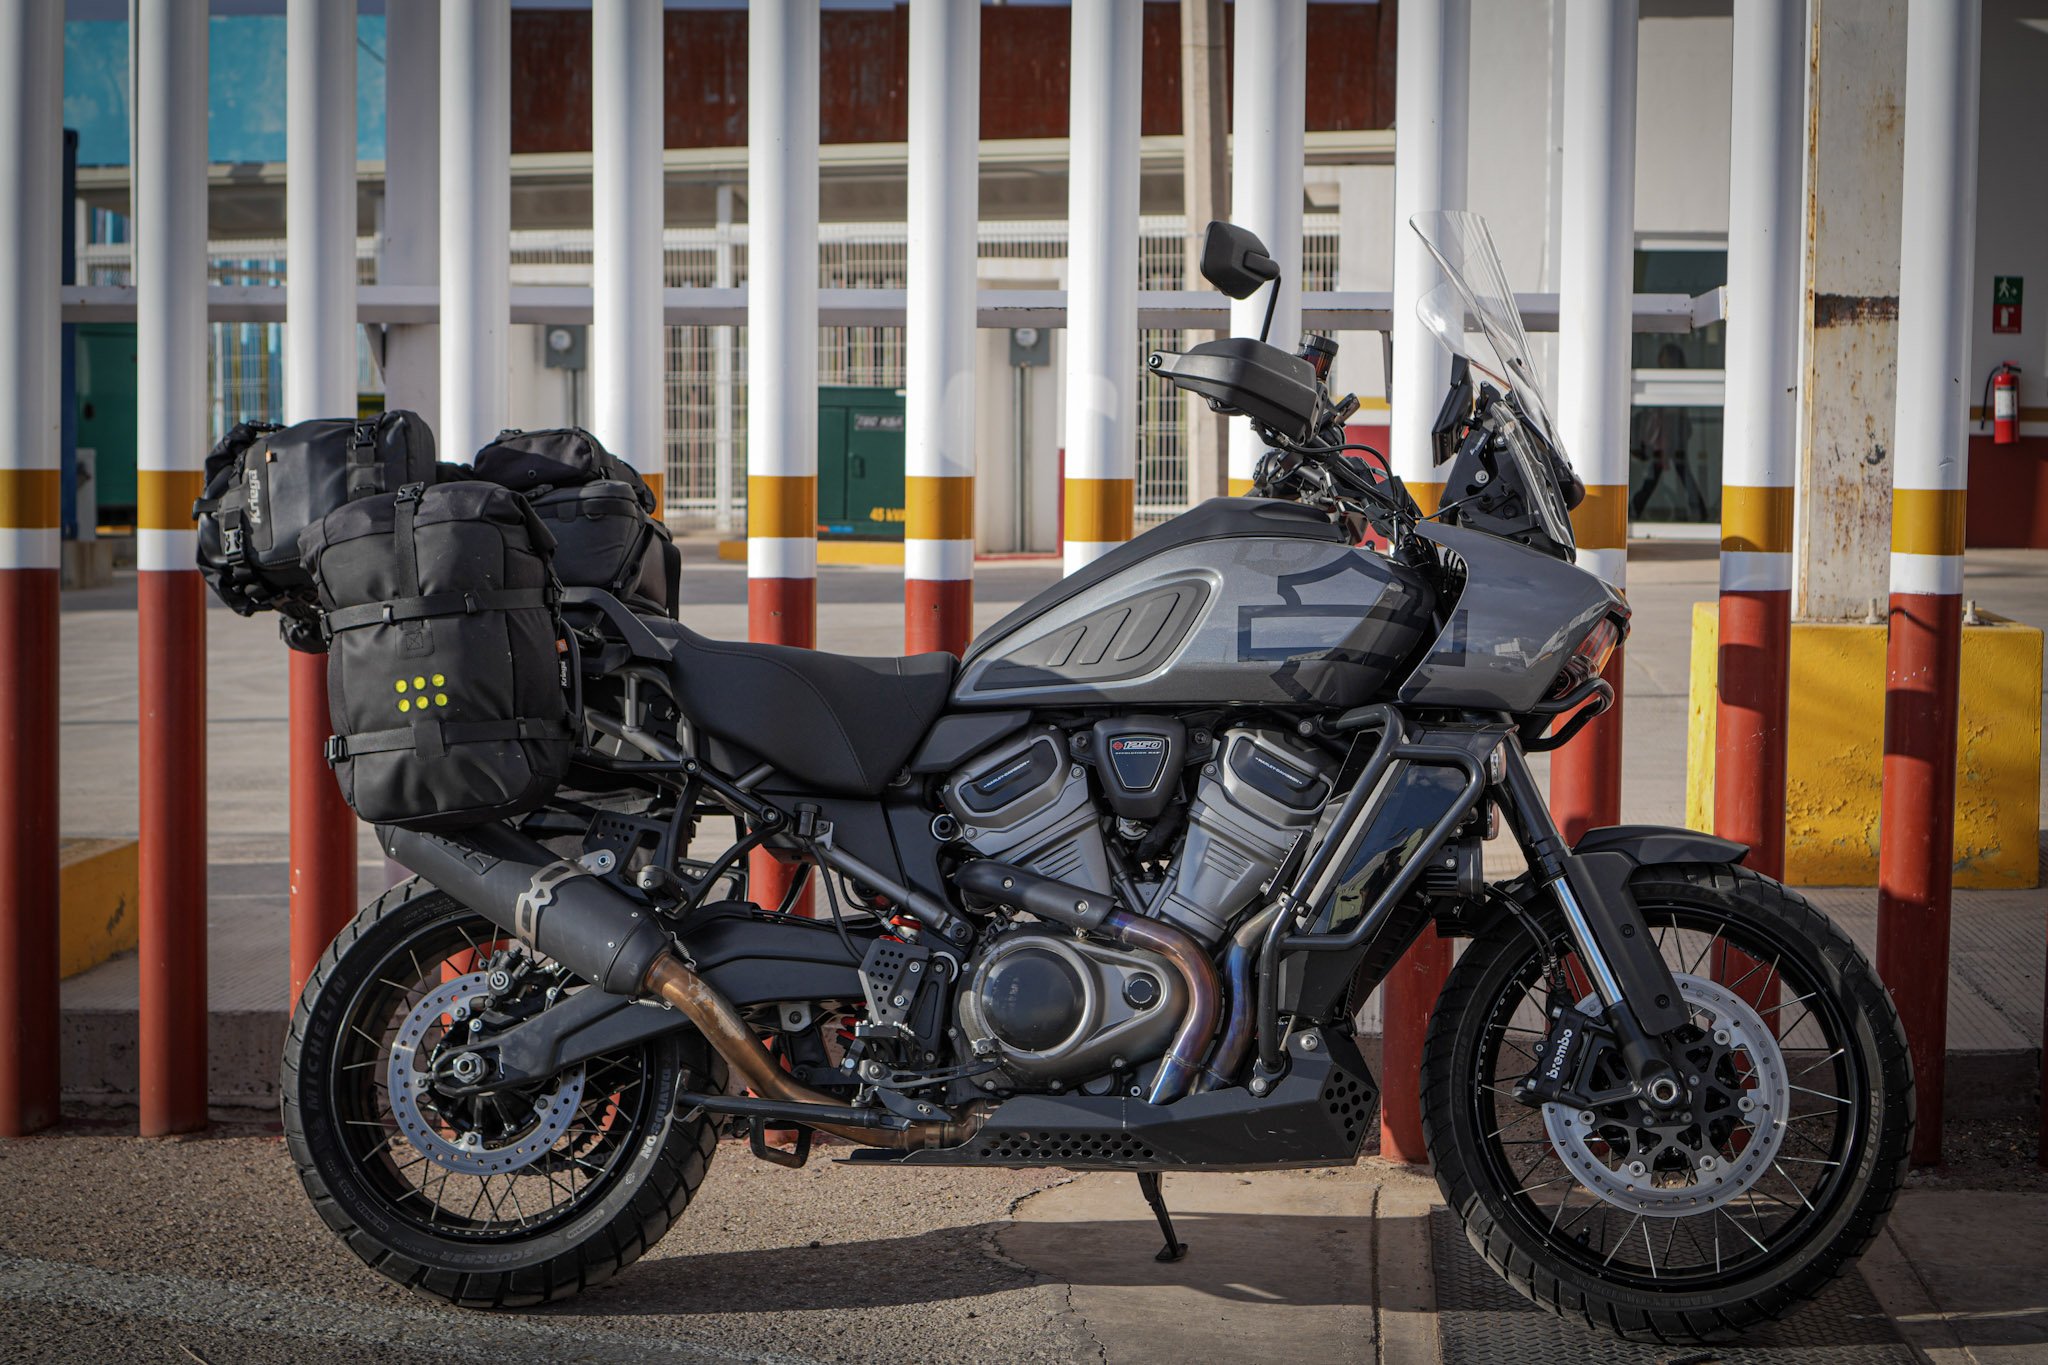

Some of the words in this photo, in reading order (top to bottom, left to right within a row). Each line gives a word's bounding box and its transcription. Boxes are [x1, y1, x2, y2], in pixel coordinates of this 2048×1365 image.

[248, 469, 261, 524] Kriega
[559, 660, 568, 687] Kriega
[1122, 740, 1162, 750] 1250
[305, 975, 347, 1110] MICHELIN
[1546, 1028, 1573, 1079] brembo
[1867, 1089, 1880, 1144] 120/70
[416, 1190, 588, 1236] HARLEY-DAVIDSON
